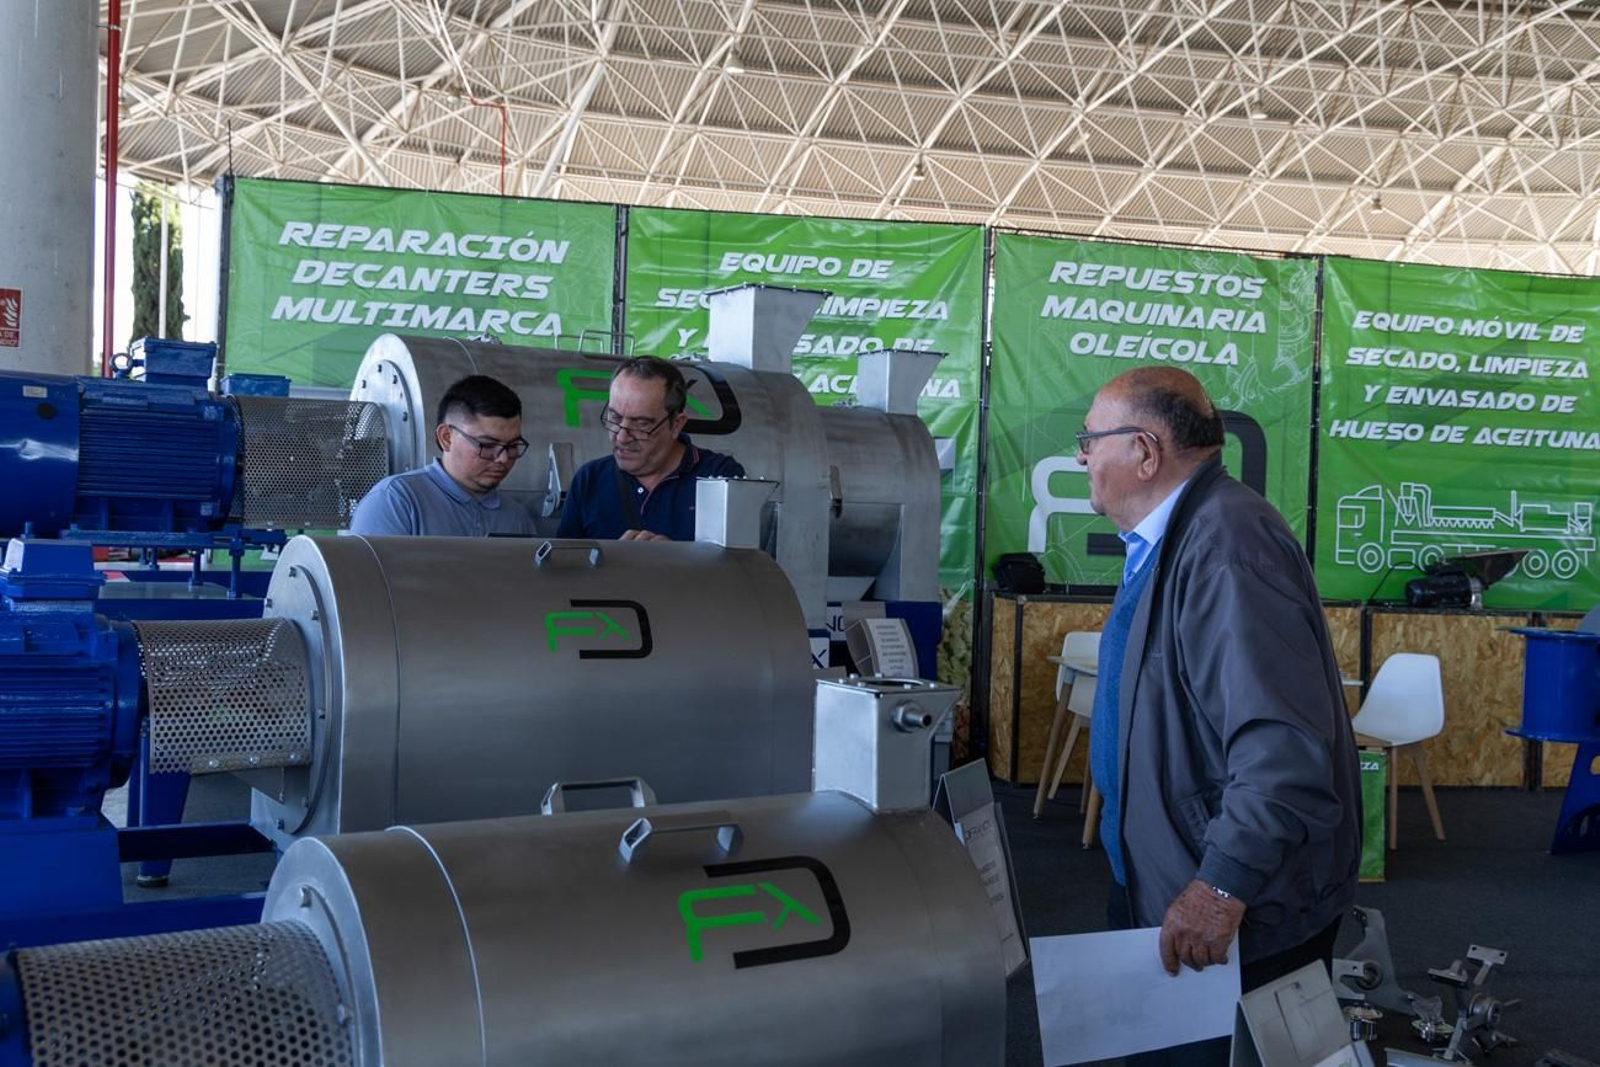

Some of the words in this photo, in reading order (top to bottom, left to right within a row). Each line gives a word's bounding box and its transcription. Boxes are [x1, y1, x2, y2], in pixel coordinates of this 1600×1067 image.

[279, 220, 571, 264] REPARACIÓN
[292, 259, 554, 300] DECANTERS
[718, 252, 845, 277] EQUIPO
[847, 258, 895, 279] DE
[1048, 260, 1267, 300] REPUESTOS
[270, 295, 563, 336] MULTIMARCA
[815, 294, 949, 320] IMPIEZA
[1040, 294, 1267, 334] MAQUINARIA
[677, 328, 699, 348] Y
[1352, 310, 1454, 336] EQUIPO
[1458, 315, 1542, 341] MÓVIL
[1548, 324, 1586, 344] DE
[1069, 330, 1239, 366] OLEÍCOLA
[1345, 347, 1462, 374] SECADO,
[1467, 354, 1589, 379] LIMPIEZA
[1363, 384, 1383, 403] Y
[1385, 386, 1536, 412] ENVASADO
[1540, 394, 1578, 414] DE
[1329, 419, 1425, 442] HUESO
[1429, 425, 1470, 444] DE
[1473, 427, 1600, 450] ACEITUNA
